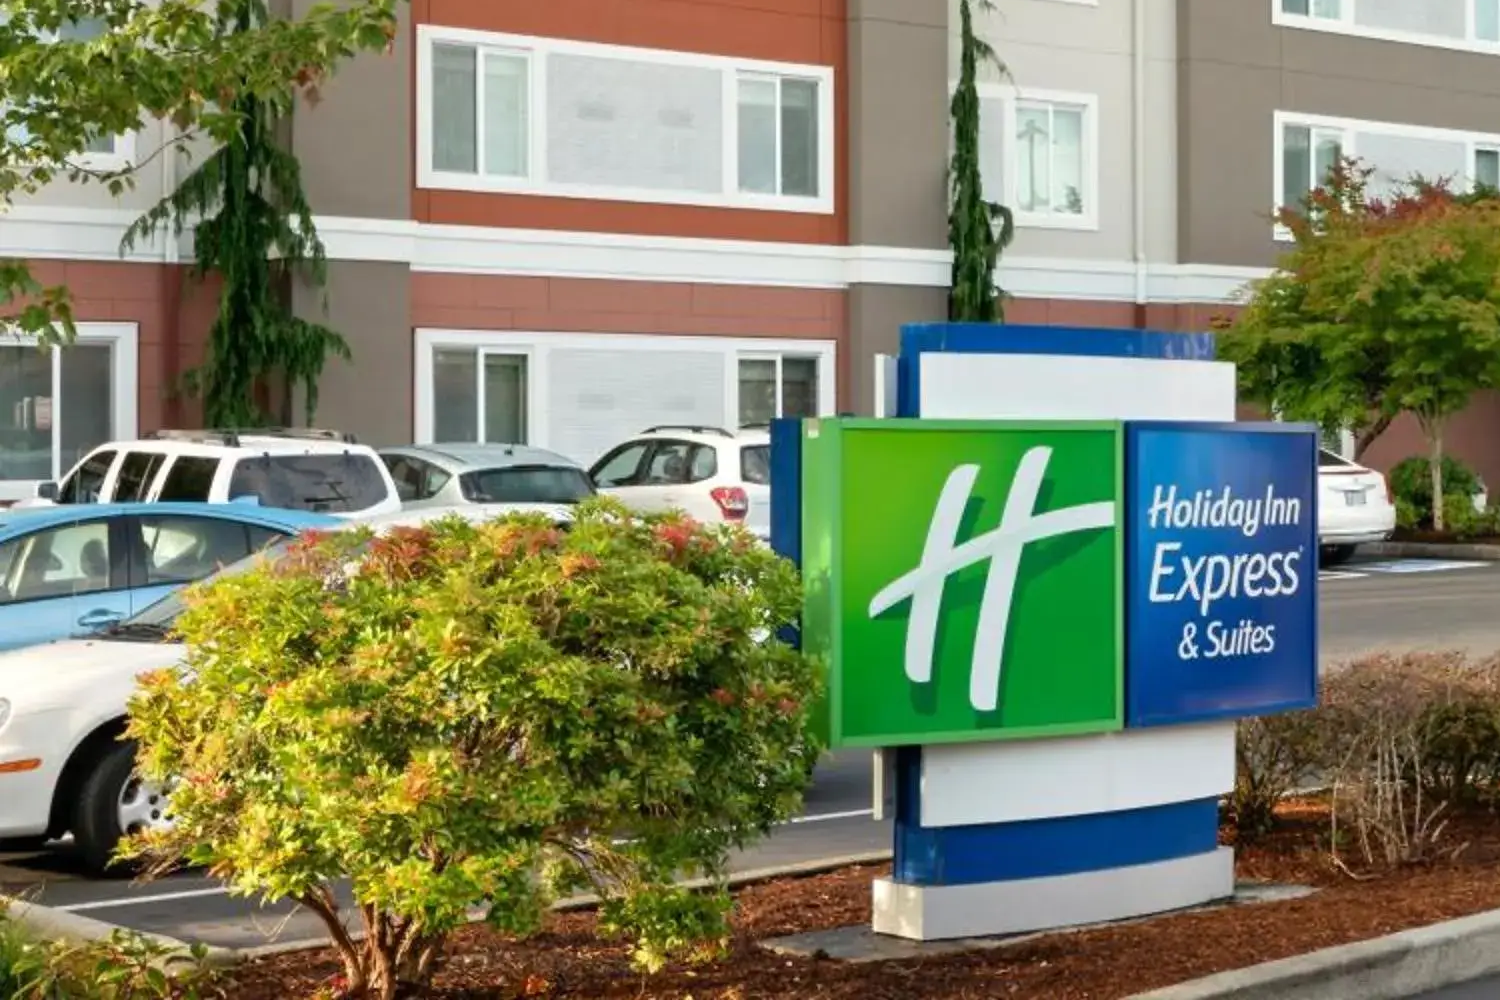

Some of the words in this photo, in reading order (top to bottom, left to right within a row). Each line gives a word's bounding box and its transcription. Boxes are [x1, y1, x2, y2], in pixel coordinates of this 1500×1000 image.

[1147, 484, 1261, 537] Holiday
[1263, 484, 1300, 527] Inn
[1149, 541, 1300, 616] Express
[1178, 621, 1199, 660] &
[1204, 619, 1275, 658] Suites
